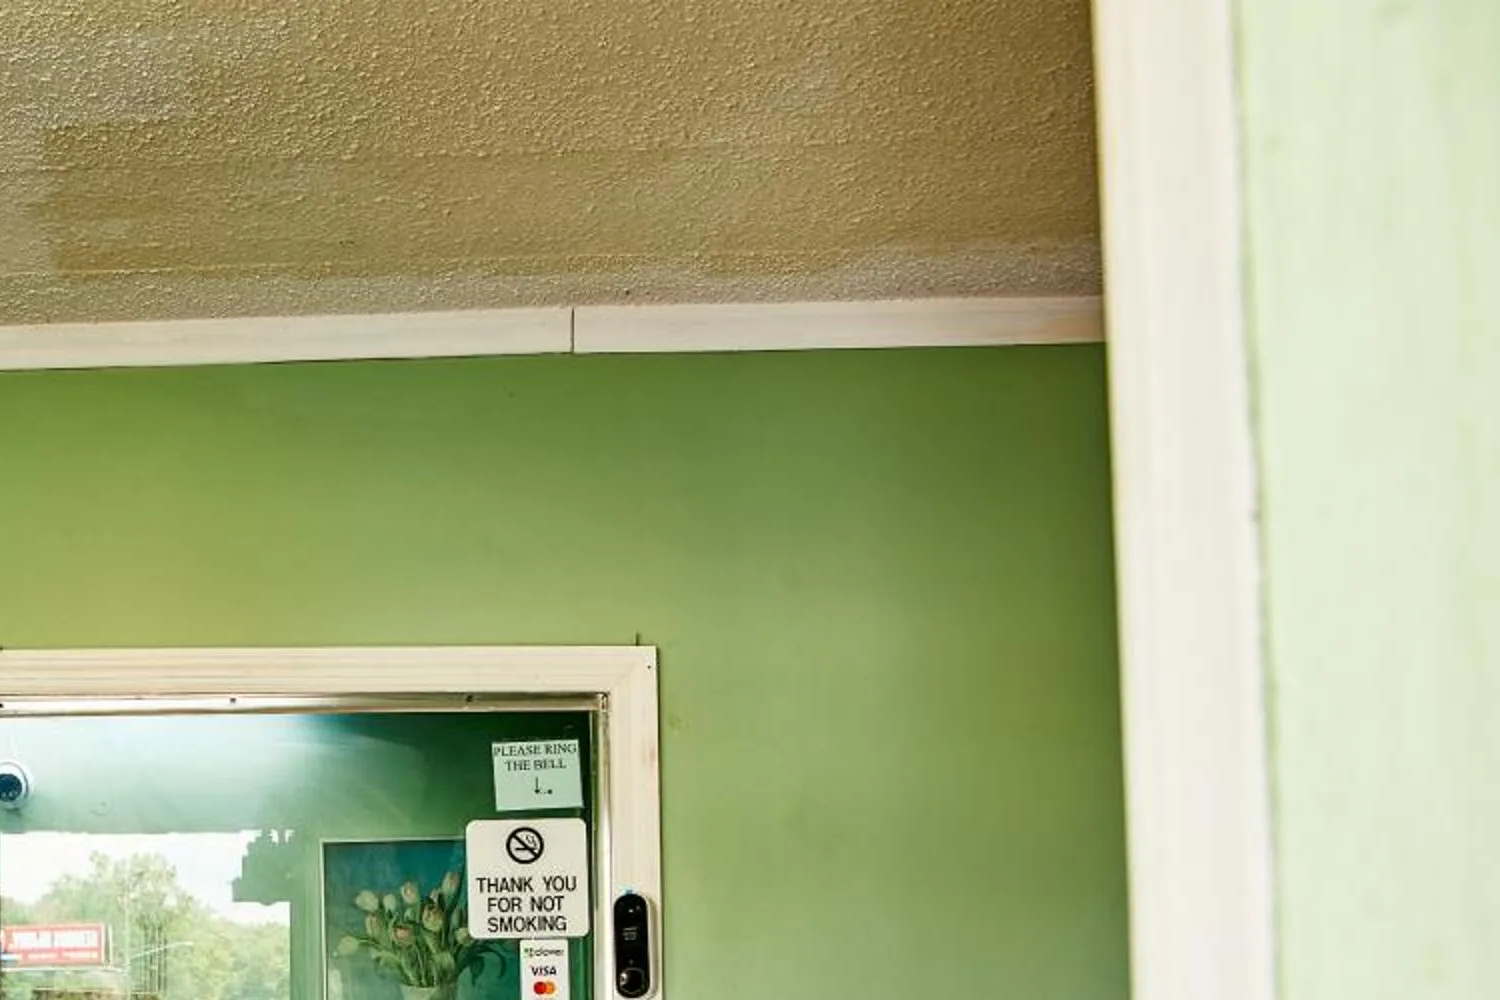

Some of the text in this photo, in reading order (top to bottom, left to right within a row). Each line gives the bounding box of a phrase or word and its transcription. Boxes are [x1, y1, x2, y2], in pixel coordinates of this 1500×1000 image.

[493, 743, 577, 757] PLEASE RING
[504, 758, 567, 772] THE BELL
[476, 875, 577, 893] THANK YOU
[487, 896, 565, 913] FOR NOT
[487, 915, 567, 933] SMOKING
[531, 966, 557, 976] VISA
